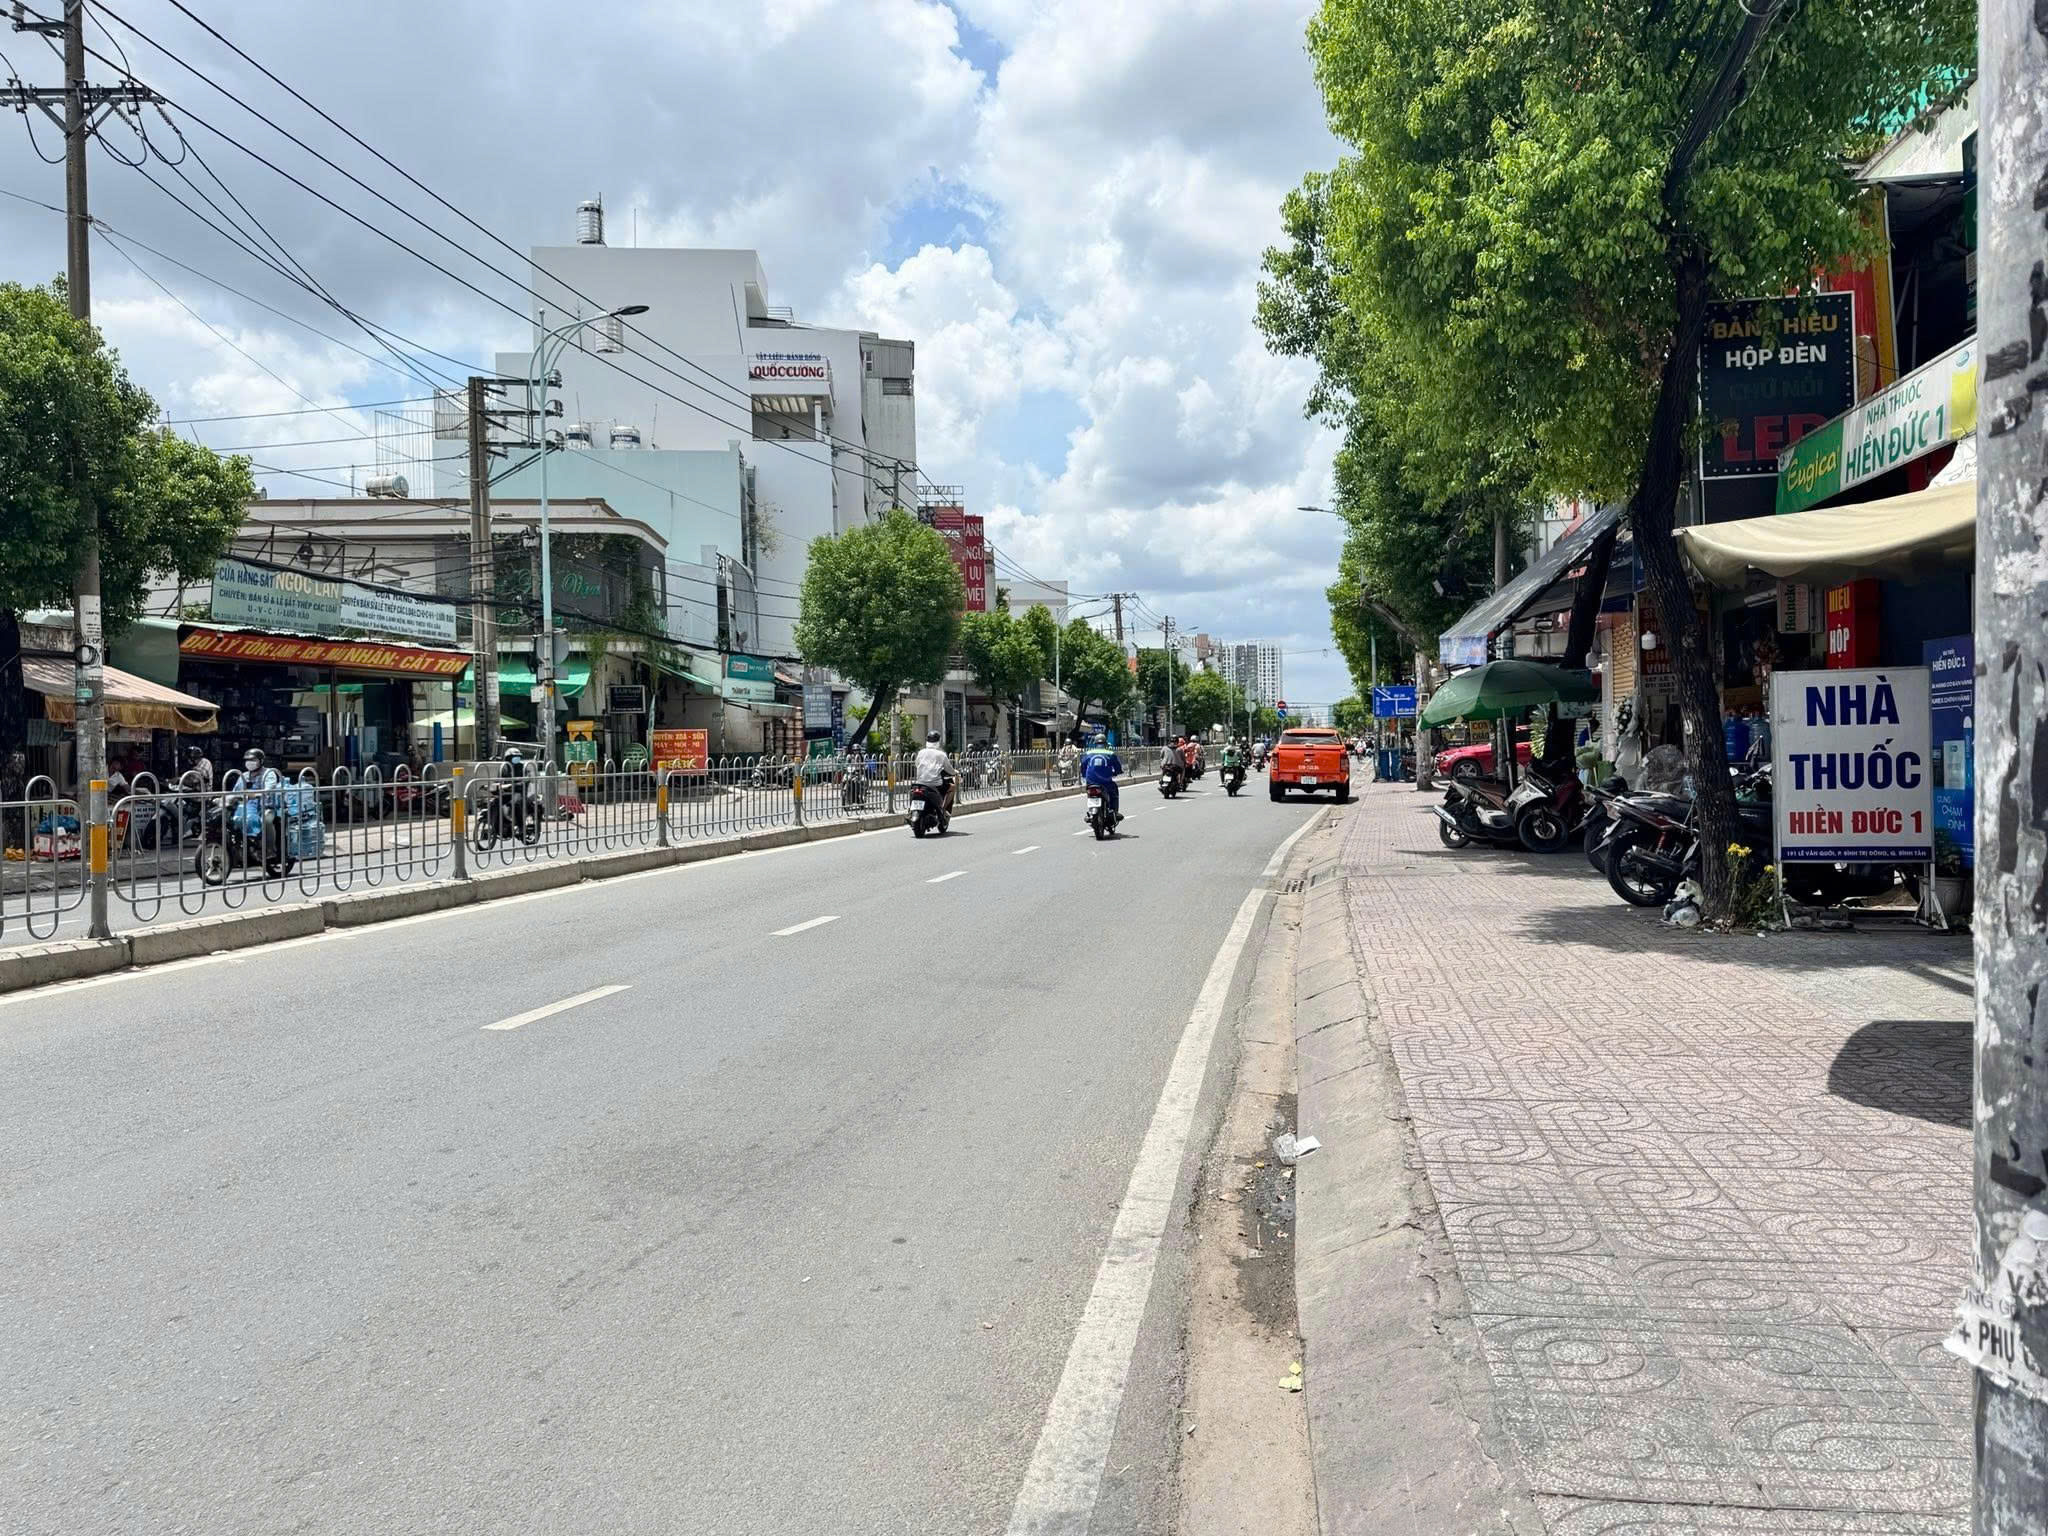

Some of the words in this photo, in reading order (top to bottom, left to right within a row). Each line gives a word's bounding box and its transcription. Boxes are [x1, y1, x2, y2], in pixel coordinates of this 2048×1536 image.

[754, 362, 786, 377] QUỐC
[1726, 345, 1772, 370] HỘP
[1778, 341, 1826, 365] ĐÈN
[1866, 398, 1887, 426] NHÀ
[1888, 380, 1923, 414] THUỐC
[1846, 429, 1885, 484] HIỀN
[1887, 411, 1929, 464] ĐỨC
[1934, 404, 1945, 441] 1
[965, 522, 984, 537] ANH
[275, 572, 311, 596] NGỌC
[315, 580, 339, 599] LAN
[966, 585, 985, 604] VIỆT
[181, 634, 216, 655] ĐẠI
[215, 637, 236, 654] LÝ
[239, 638, 271, 657] TÔN:
[346, 645, 397, 668] NHẬN:
[434, 655, 466, 674] TÔN
[1829, 624, 1850, 658] HỘP
[1806, 675, 1899, 726] NHÀ
[1789, 738, 1921, 790] THUỐC
[1790, 804, 1843, 834] HIỀN
[1851, 807, 1902, 833] ĐỨC
[1911, 811, 1922, 833] 1
[1979, 1321, 2015, 1370] PHỤ
